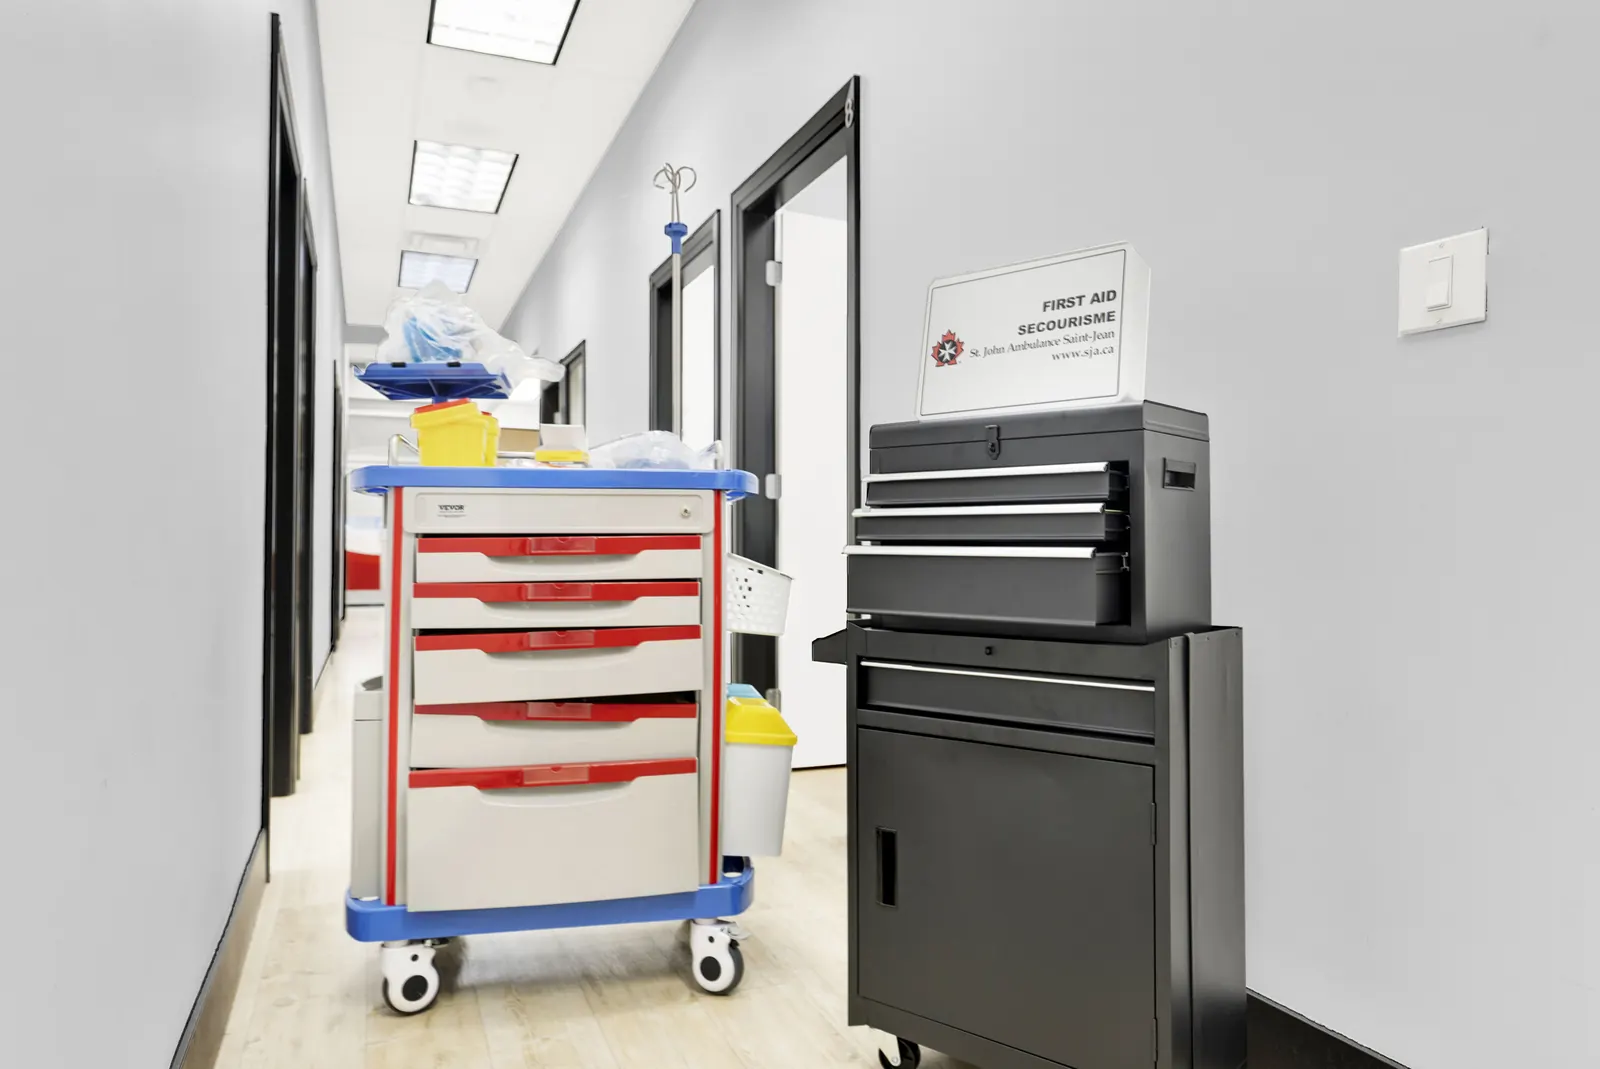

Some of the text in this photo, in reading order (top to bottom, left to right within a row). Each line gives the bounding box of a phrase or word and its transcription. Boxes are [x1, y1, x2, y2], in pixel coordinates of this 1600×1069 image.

[845, 98, 854, 128] 8
[1043, 289, 1117, 312] FIRST AID
[1017, 311, 1116, 336] SECOURISME
[969, 329, 1115, 359] St. John Ambulance Saint-Jean
[1051, 345, 1115, 362] www.sja.ca
